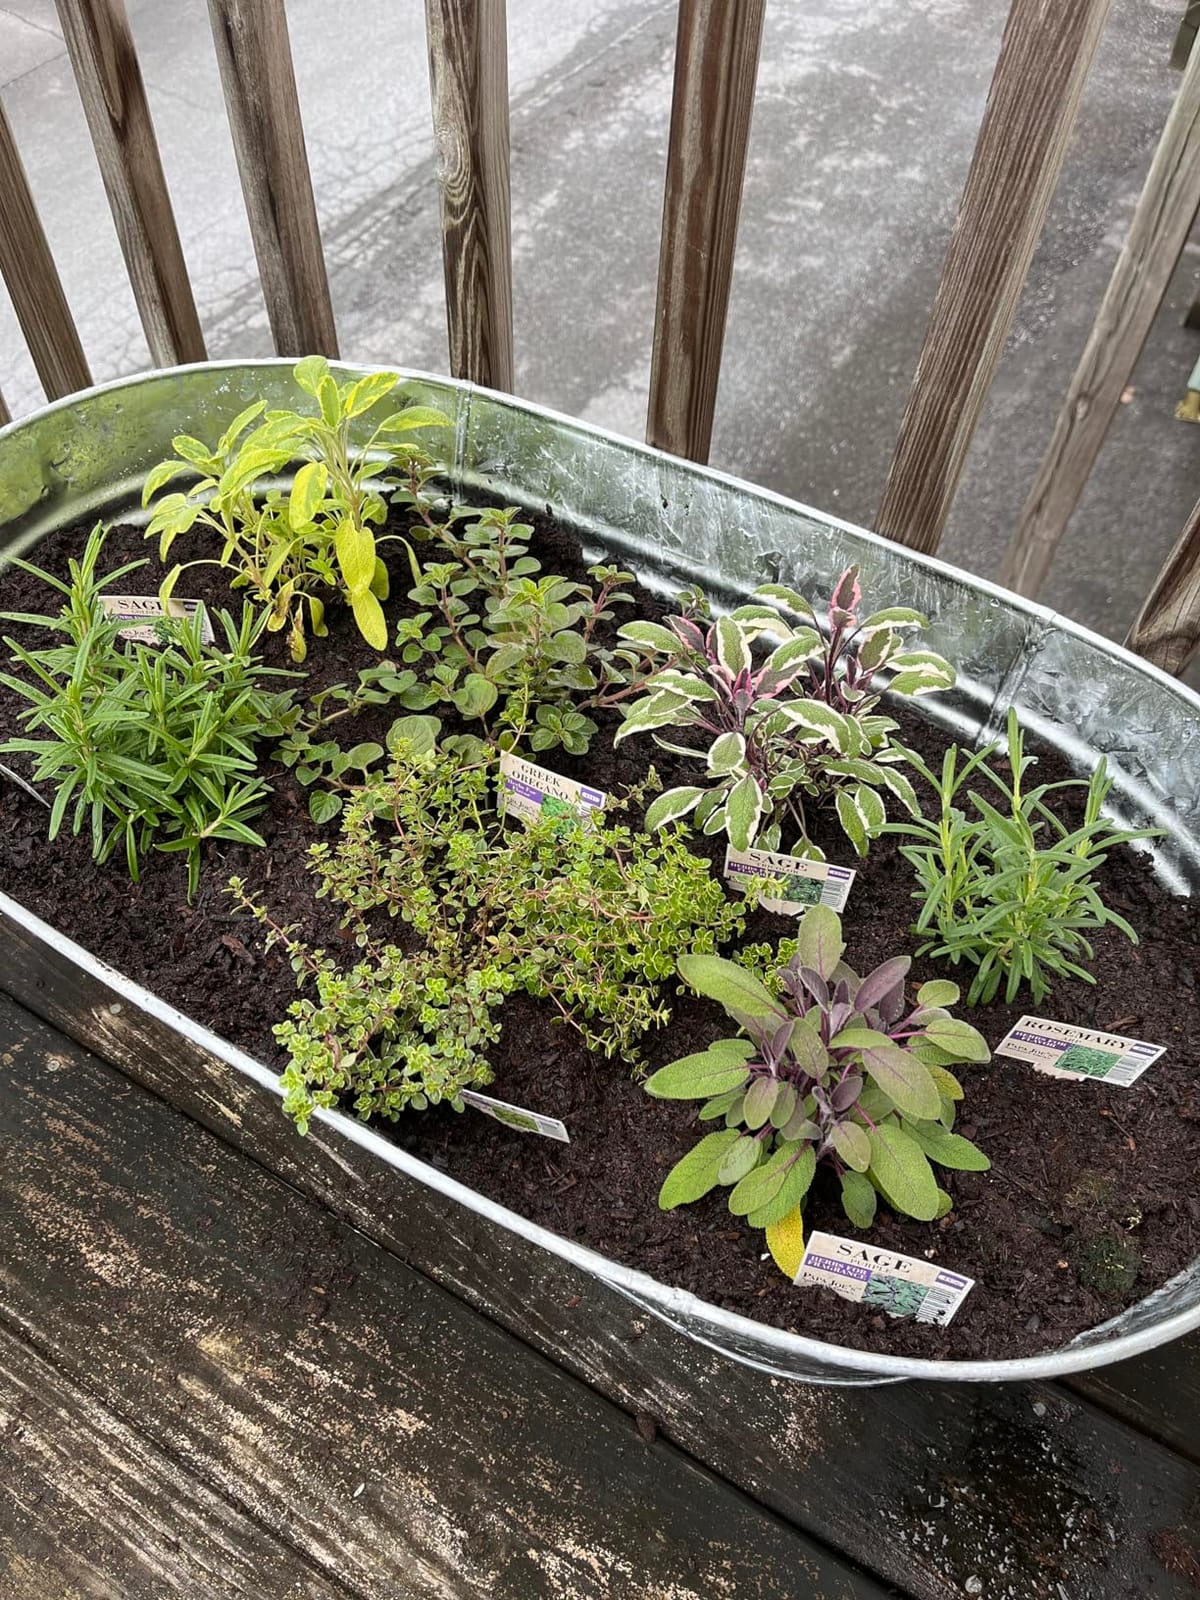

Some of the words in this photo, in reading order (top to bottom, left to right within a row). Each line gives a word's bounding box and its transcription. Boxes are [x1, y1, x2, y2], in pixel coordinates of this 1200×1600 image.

[512, 770, 569, 800] OREGANO
[521, 764, 560, 787] GREEK
[749, 852, 808, 872] SAGE
[1015, 1031, 1047, 1042] HERBS
[1023, 1020, 1132, 1049] ROSEMARY
[810, 1255, 846, 1268] HERBS
[847, 1265, 868, 1275] FOR
[836, 1243, 912, 1274] SAGE
[850, 1258, 892, 1273] PURPLE
[802, 1272, 827, 1284] PAPA
[807, 1260, 868, 1281] FRAGRANCE
